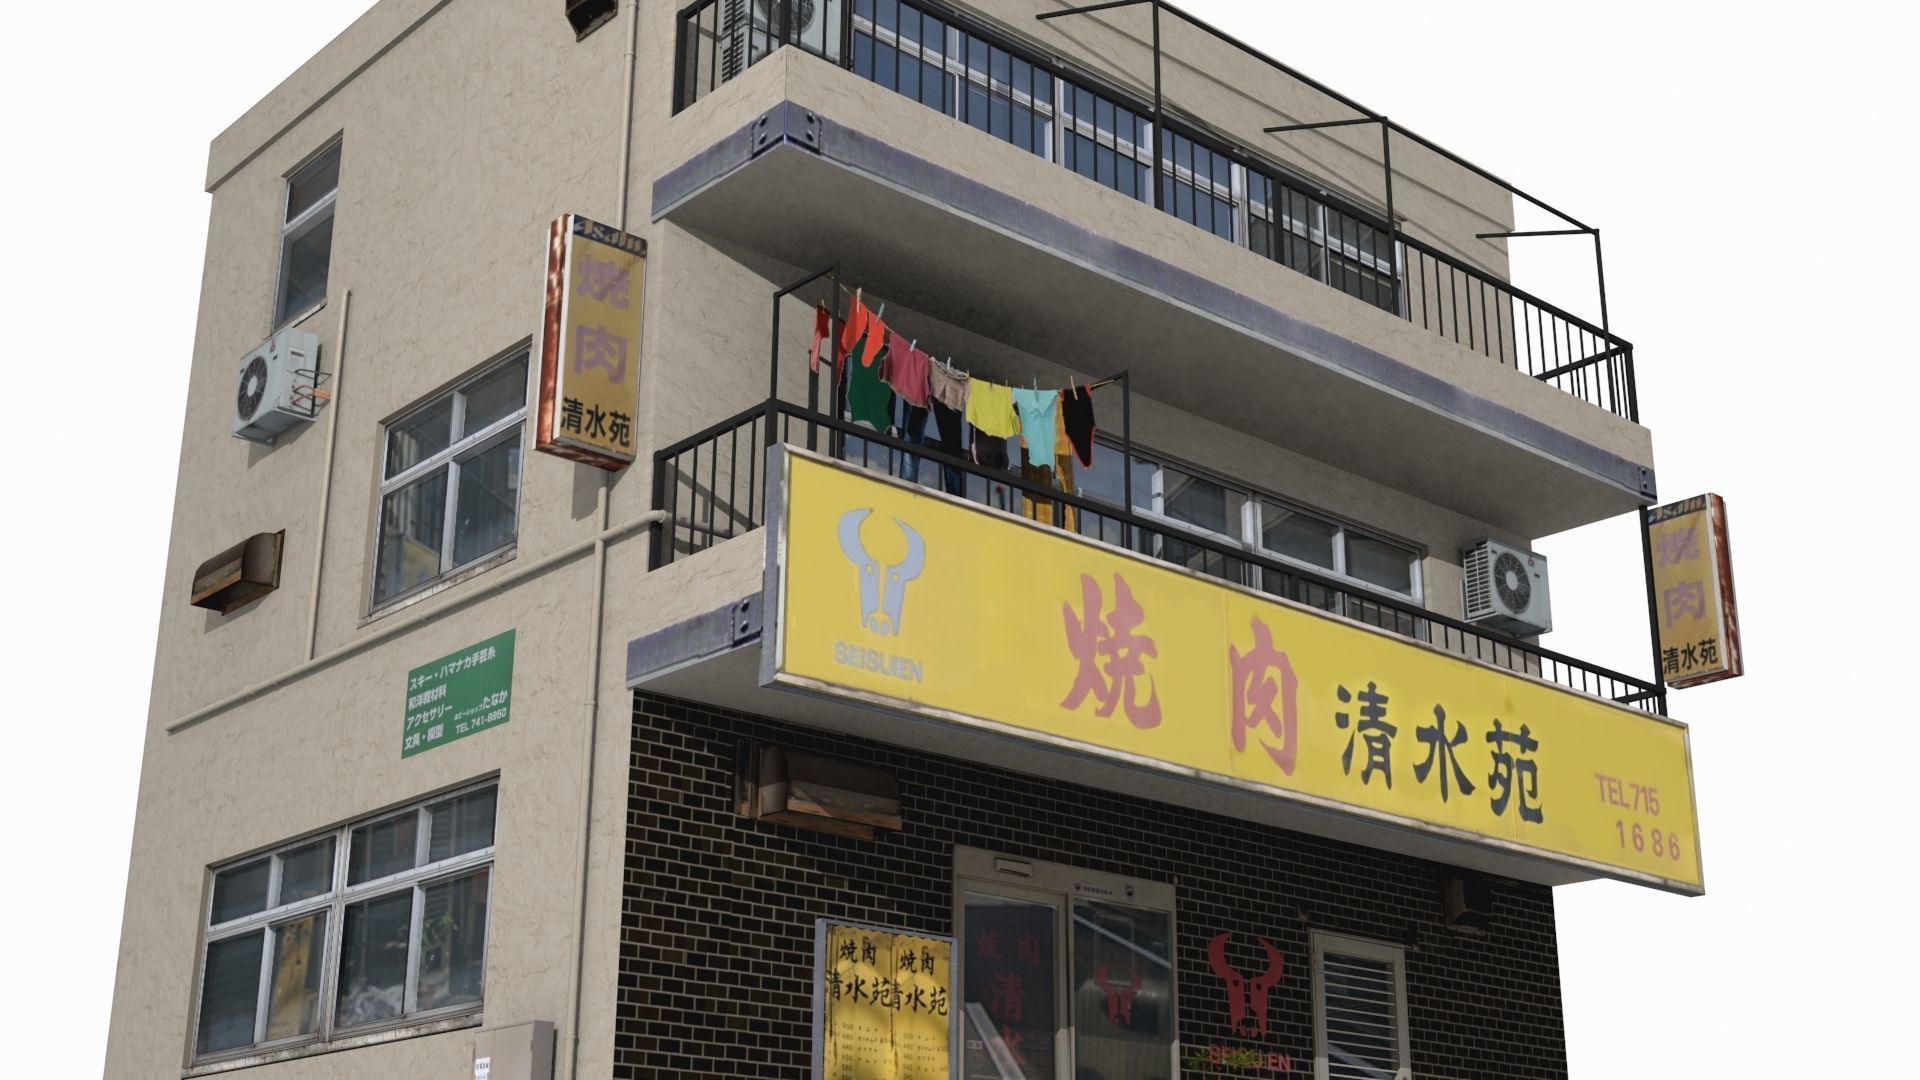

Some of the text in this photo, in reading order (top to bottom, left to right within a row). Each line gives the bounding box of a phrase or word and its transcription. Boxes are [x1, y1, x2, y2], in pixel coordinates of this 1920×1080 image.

[574, 254, 631, 385] 焼肉
[560, 395, 631, 448] 清水苑
[1657, 526, 1706, 629] 焼肉
[834, 640, 924, 684] SEISUIEN
[1661, 637, 1719, 675] 清水苑
[406, 703, 453, 730] アクセサリー
[1060, 572, 1544, 824] 焼肉 清水苑
[455, 722, 469, 735] TEL
[1616, 818, 1681, 861] 1686
[839, 939, 876, 966] 焼肉
[899, 949, 934, 976] 焼肉
[827, 967, 892, 1007] 清水苑
